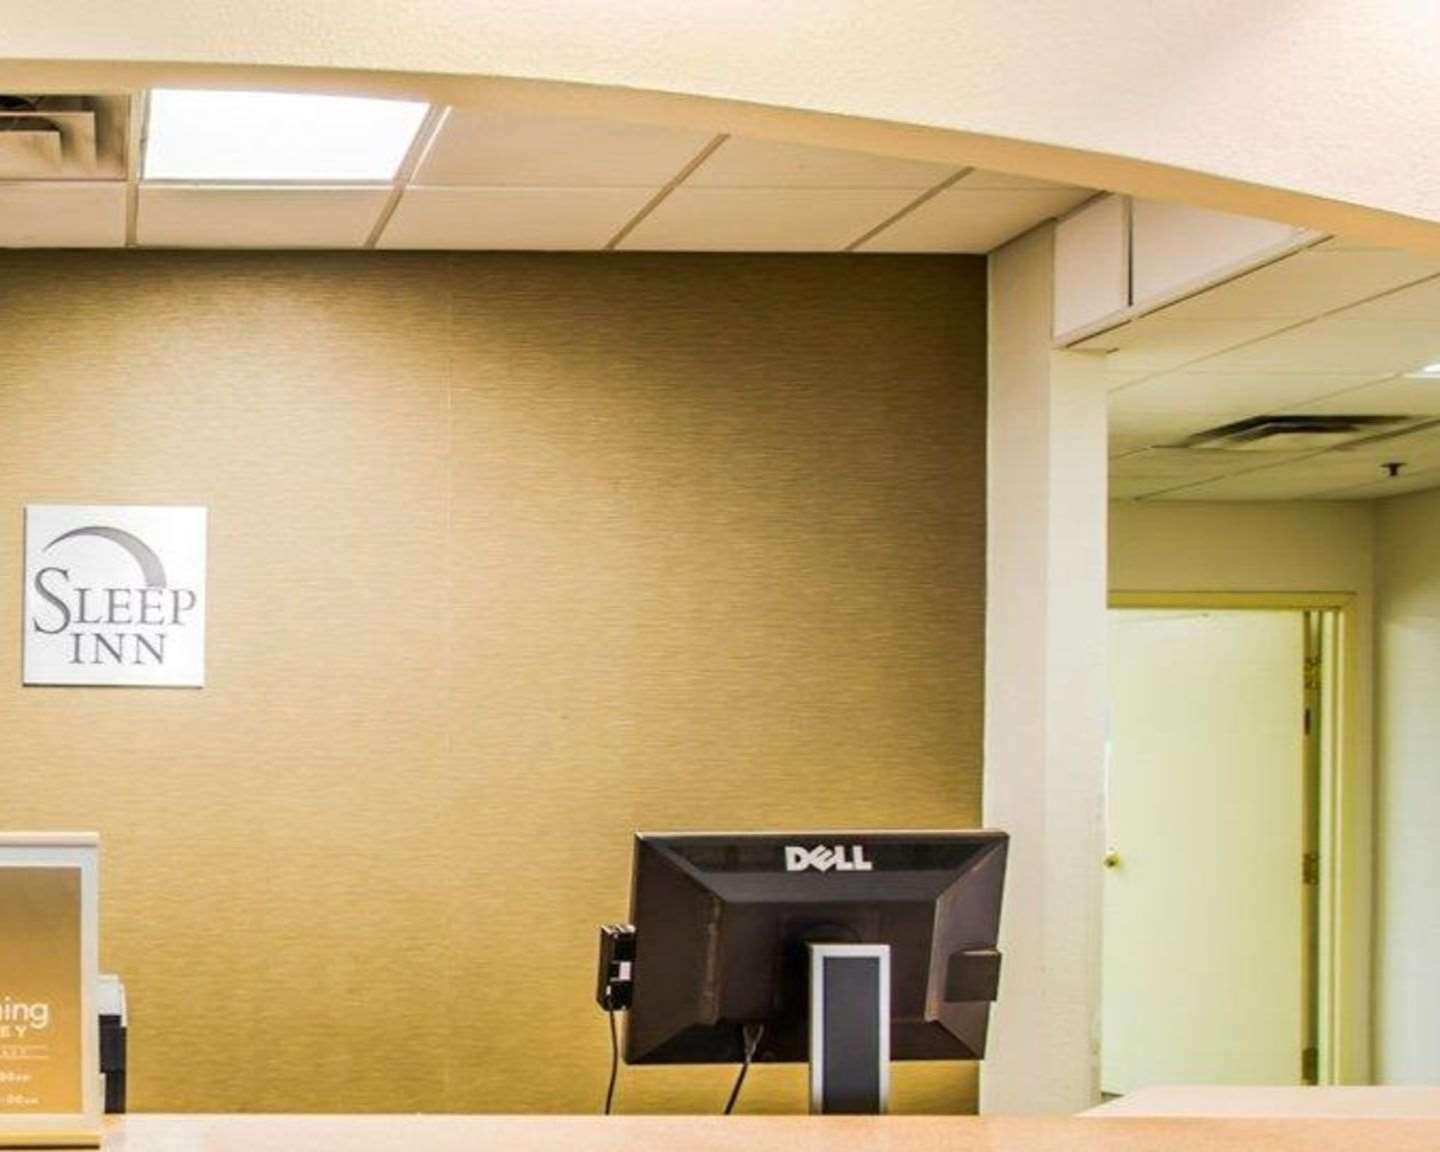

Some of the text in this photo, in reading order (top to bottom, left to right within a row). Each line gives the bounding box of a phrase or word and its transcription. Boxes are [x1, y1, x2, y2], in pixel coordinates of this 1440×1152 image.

[33, 567, 197, 634] SLEEP
[69, 633, 167, 665] INN
[785, 844, 873, 871] DELL
